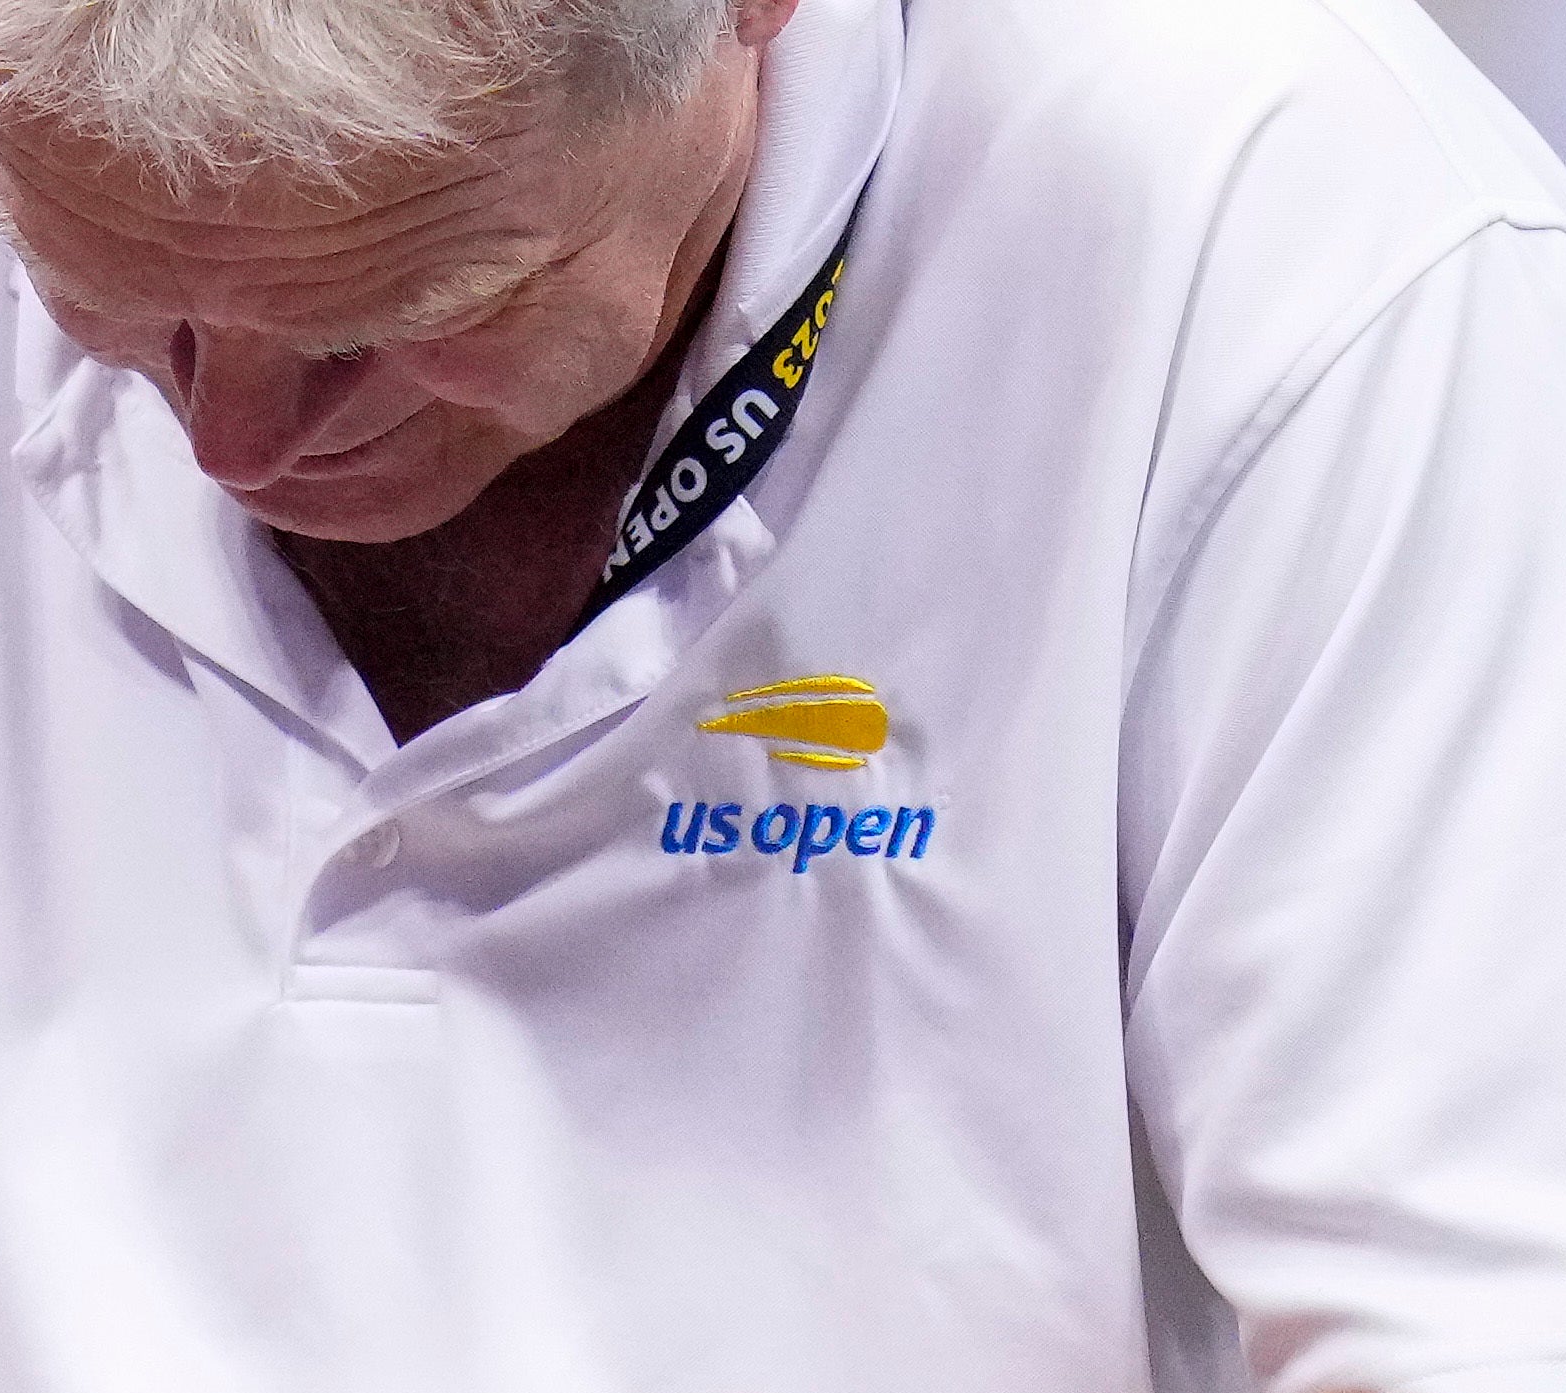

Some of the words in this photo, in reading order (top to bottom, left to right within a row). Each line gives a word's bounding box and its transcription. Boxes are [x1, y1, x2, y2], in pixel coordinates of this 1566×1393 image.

[772, 258, 845, 389] 023
[705, 388, 780, 465] US
[661, 801, 742, 855] us
[751, 802, 936, 875] open
